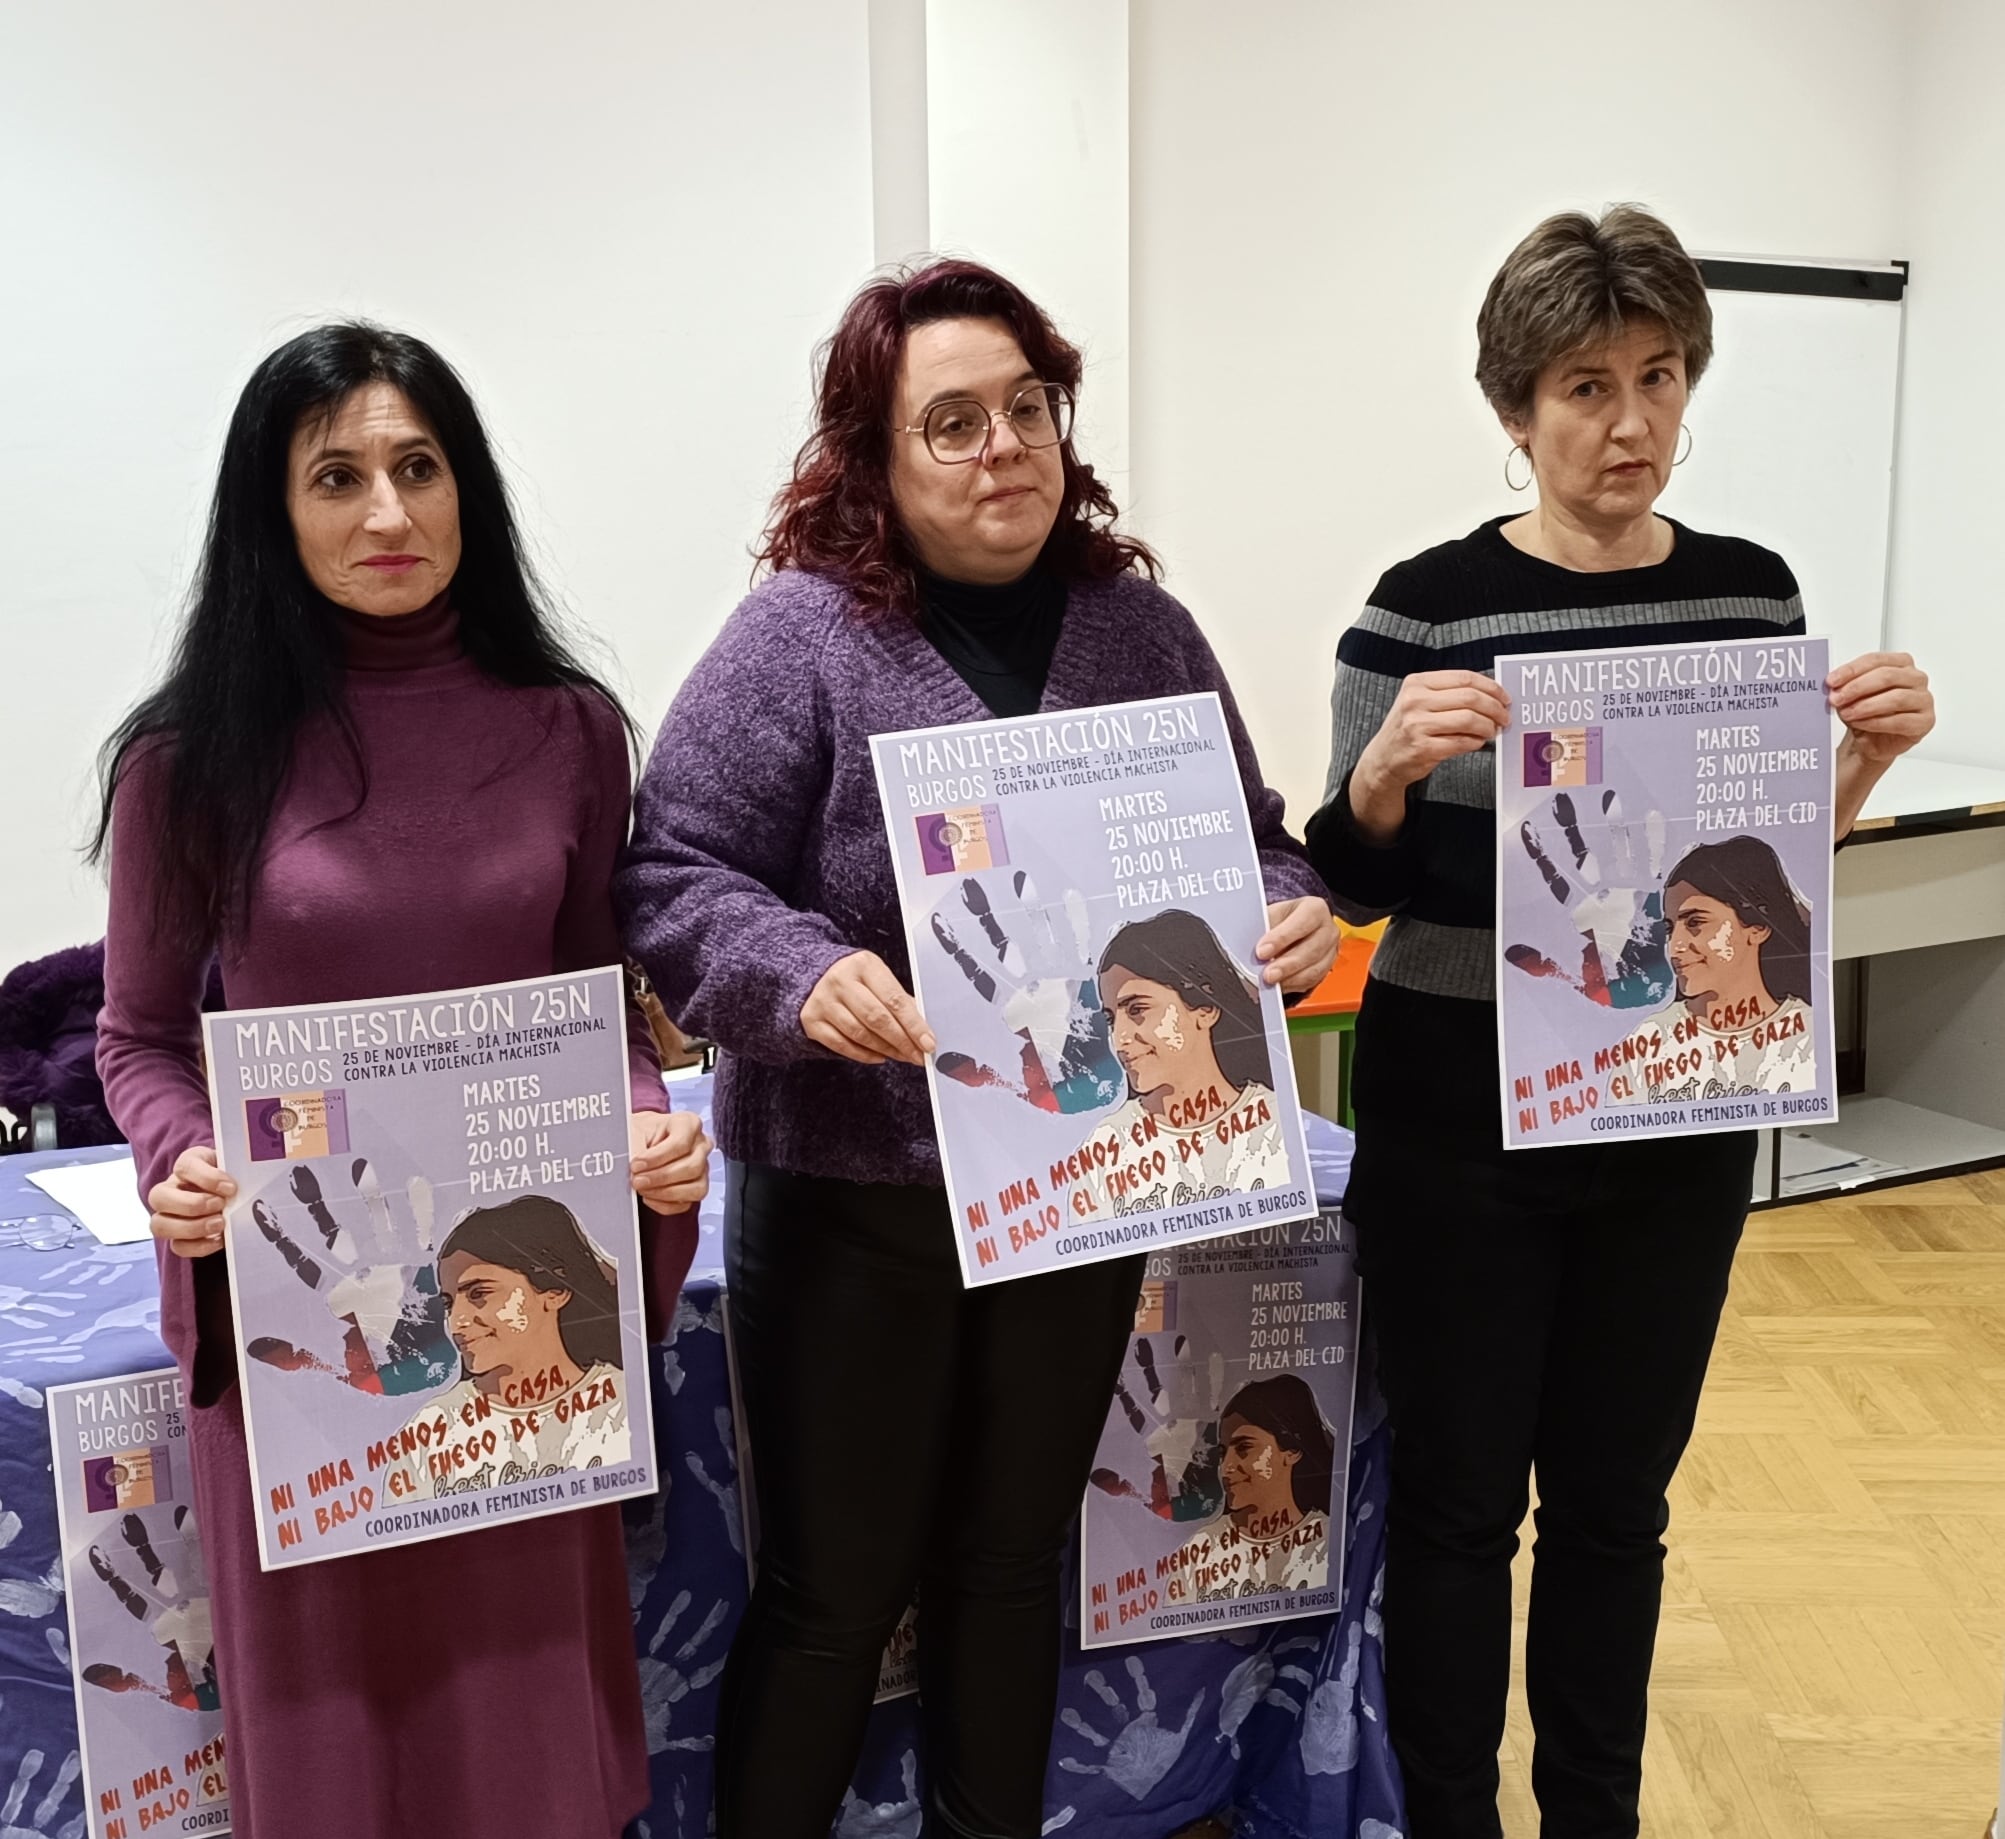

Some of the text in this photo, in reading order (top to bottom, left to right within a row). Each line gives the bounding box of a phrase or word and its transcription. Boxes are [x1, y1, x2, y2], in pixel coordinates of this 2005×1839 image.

[1521, 646, 1805, 696] MANIFESTACIÓN 25N
[1521, 698, 1594, 724] BURGOS
[1602, 679, 1818, 706] 25 DE NOVIEMBRE DÍA INTERNACIONAL
[1602, 696, 1778, 719] CONTRA LA VIOLENCIA MACHISTA
[898, 706, 1199, 777] MANIFESTACIÓN 25N
[1696, 725, 1760, 750] MARTES
[991, 738, 1216, 781] 25 DE NOVIEMBRE DÍA INTERNACIONAL
[994, 758, 1178, 795] CONTRA LA VIOLENCIA MACHISTA
[1696, 748, 1818, 777] 25 NOVIEMBRE
[906, 774, 987, 807] BURGOS
[1098, 789, 1168, 821] MARTES
[1696, 778, 1767, 804] 20:00 H.
[1103, 809, 1234, 850] 25 NOVIEMBRE
[1696, 801, 1816, 831] PLAZA DEL CID
[1110, 846, 1188, 879] 20:00 H.
[1115, 866, 1244, 908] PLAZA DEL CID
[234, 982, 590, 1060] MANIFESTACIÓN 25N
[342, 1017, 607, 1066] 25 DE NOVIEMBRE DÍA INTERNACIONAL
[343, 1040, 560, 1081] CONTRA LA VIOLENCIA MACHISTA
[1515, 1075, 1533, 1102] NI
[1545, 1060, 1582, 1091] UNA
[1594, 1029, 1661, 1074] MENOS
[1673, 1014, 1698, 1043] EN
[239, 1058, 333, 1090] BURGOS
[462, 1074, 541, 1107] MARTES
[1519, 1107, 1538, 1133] NI
[1549, 1086, 1598, 1124] BAJO
[1611, 1075, 1633, 1099] EL
[1644, 1047, 1701, 1088] FUEGO
[1714, 1034, 1738, 1062] DE
[1751, 1011, 1804, 1049] GAZA
[465, 1092, 612, 1137] 25 NOVIEMBRE
[1591, 1097, 1827, 1131] COORDINADORA FEMINISTA DE BURGOS
[466, 1131, 555, 1165] 20:00 H.
[468, 1149, 615, 1194] PLAZA DEL CID
[966, 1199, 989, 1232] NI
[998, 1177, 1040, 1215] UNA
[1048, 1133, 1118, 1190] MENOS
[1130, 1112, 1158, 1146] EN
[976, 1236, 999, 1268] NI
[1007, 1205, 1058, 1253] BAJO
[1072, 1188, 1097, 1216] EL
[1105, 1149, 1165, 1200] FUEGO
[1176, 1130, 1204, 1163] DE
[1215, 1098, 1270, 1144] GAZA
[1055, 1221, 1158, 1256] COORDINADORA
[1162, 1205, 1233, 1233] FEMINISTA
[1237, 1201, 1253, 1218] DE
[1257, 1190, 1306, 1214] BURGOS
[1300, 1215, 1340, 1243] 25N
[1252, 1281, 1302, 1302] MARTES
[1251, 1301, 1347, 1325] 25 NOVIEMBRE
[1250, 1327, 1289, 1348] 20:00
[1248, 1345, 1344, 1370] PLAZA DEL CID
[78, 1419, 158, 1452] BURGOS
[166, 1412, 180, 1425] 25
[270, 1482, 294, 1514] NI
[307, 1459, 353, 1497] UNA
[366, 1413, 446, 1471] MENOS
[460, 1392, 491, 1426] EN
[277, 1519, 301, 1551] NI
[314, 1486, 373, 1534] BAJO
[388, 1468, 416, 1497] EL
[428, 1429, 496, 1480] FUEGO
[510, 1409, 539, 1442] DE
[554, 1377, 616, 1423] GAZA
[365, 1500, 480, 1537] COORDINADORA
[486, 1483, 563, 1513] FEMINISTA
[571, 1478, 586, 1496] DE
[593, 1466, 645, 1492] BURGOS
[1092, 1583, 1106, 1606] NI
[1117, 1566, 1146, 1596] UNA
[1156, 1538, 1209, 1578] MENOS
[1220, 1525, 1239, 1550] EN
[1094, 1610, 1108, 1634] NI
[1119, 1590, 1157, 1624] BAJO
[1168, 1579, 1185, 1600] EL
[1195, 1553, 1240, 1589] FUEGO
[1251, 1541, 1269, 1565] DE
[1280, 1520, 1322, 1553] GAZA
[1150, 1591, 1334, 1629] COORDINADORA FEMINISTA DE BURGOS
[100, 1737, 225, 1815] NI UNA MEN
[138, 1789, 189, 1830] BAJO
[203, 1772, 226, 1796] EL
